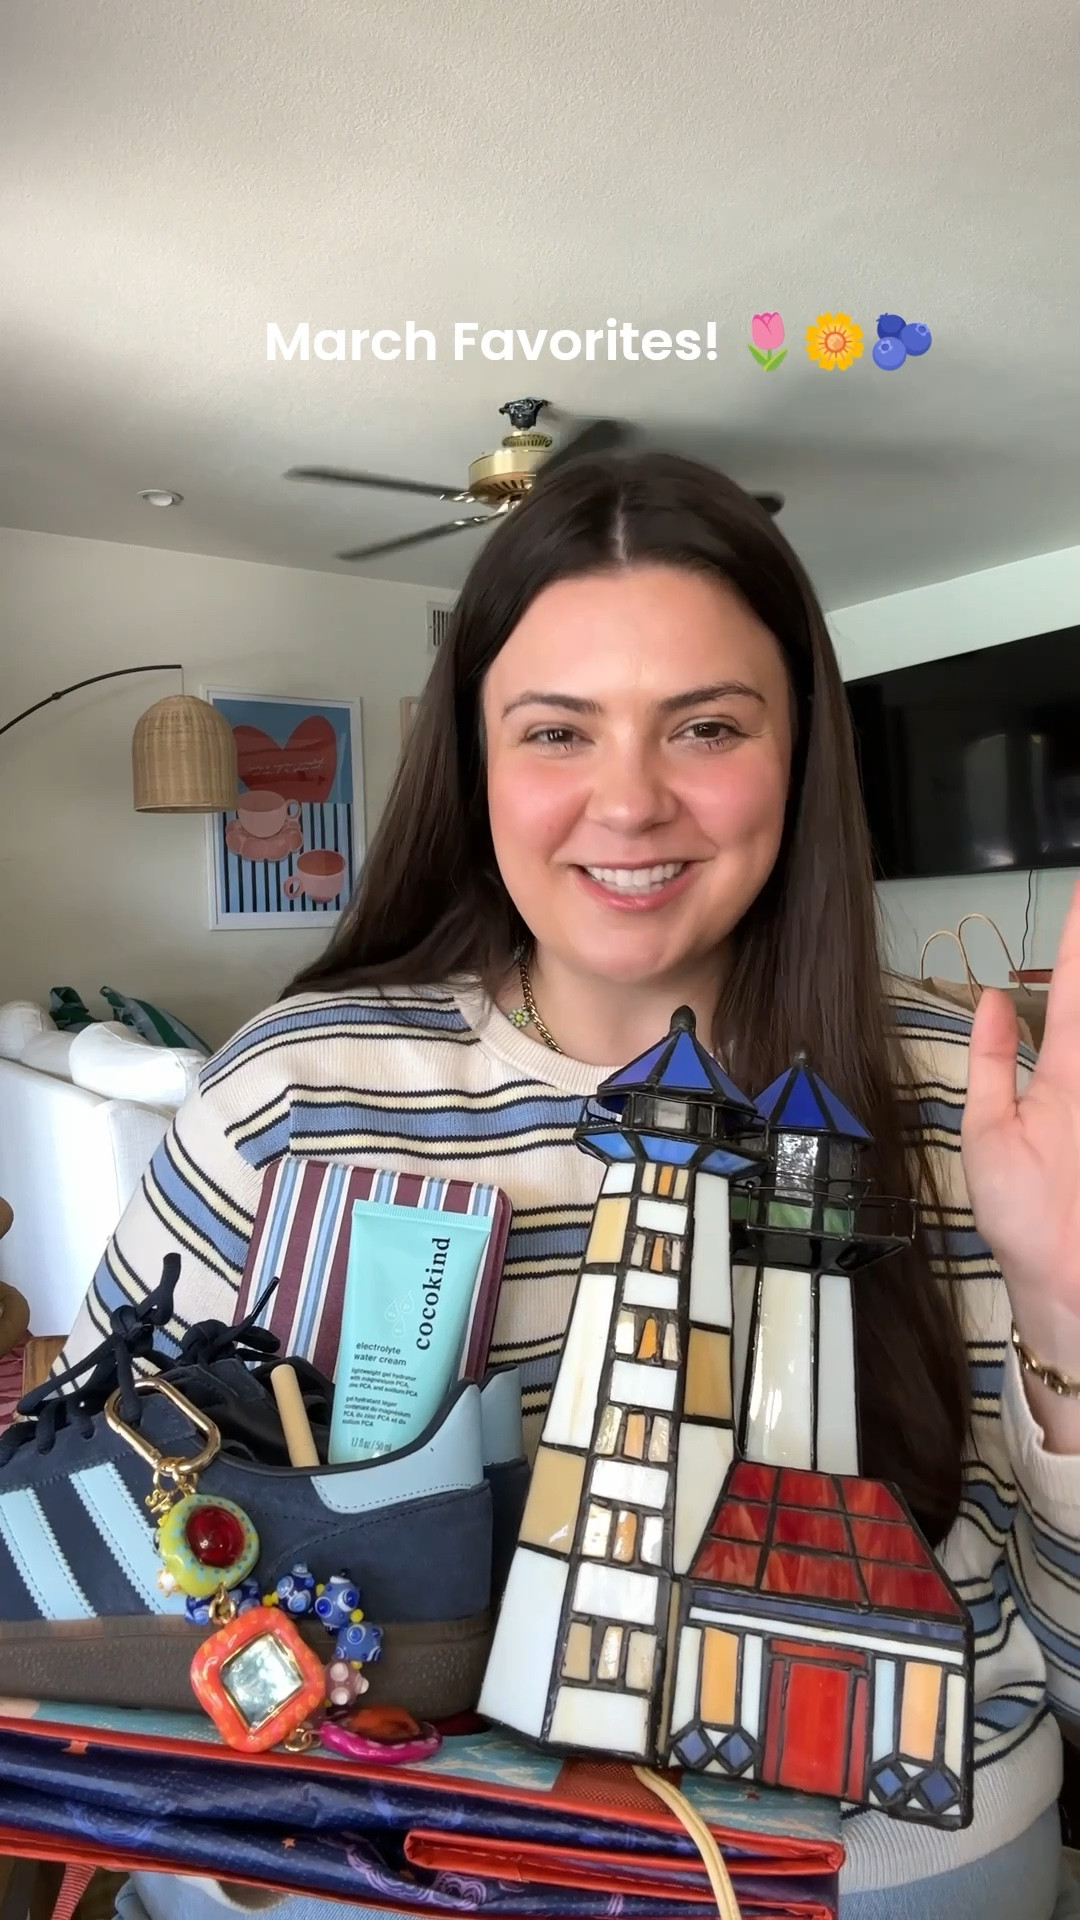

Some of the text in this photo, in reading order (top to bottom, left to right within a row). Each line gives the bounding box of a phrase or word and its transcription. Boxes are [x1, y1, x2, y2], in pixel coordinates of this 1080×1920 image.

[416, 1237, 451, 1351] cocokind
[356, 1342, 401, 1355] electrolyte
[354, 1354, 407, 1366] water cream
